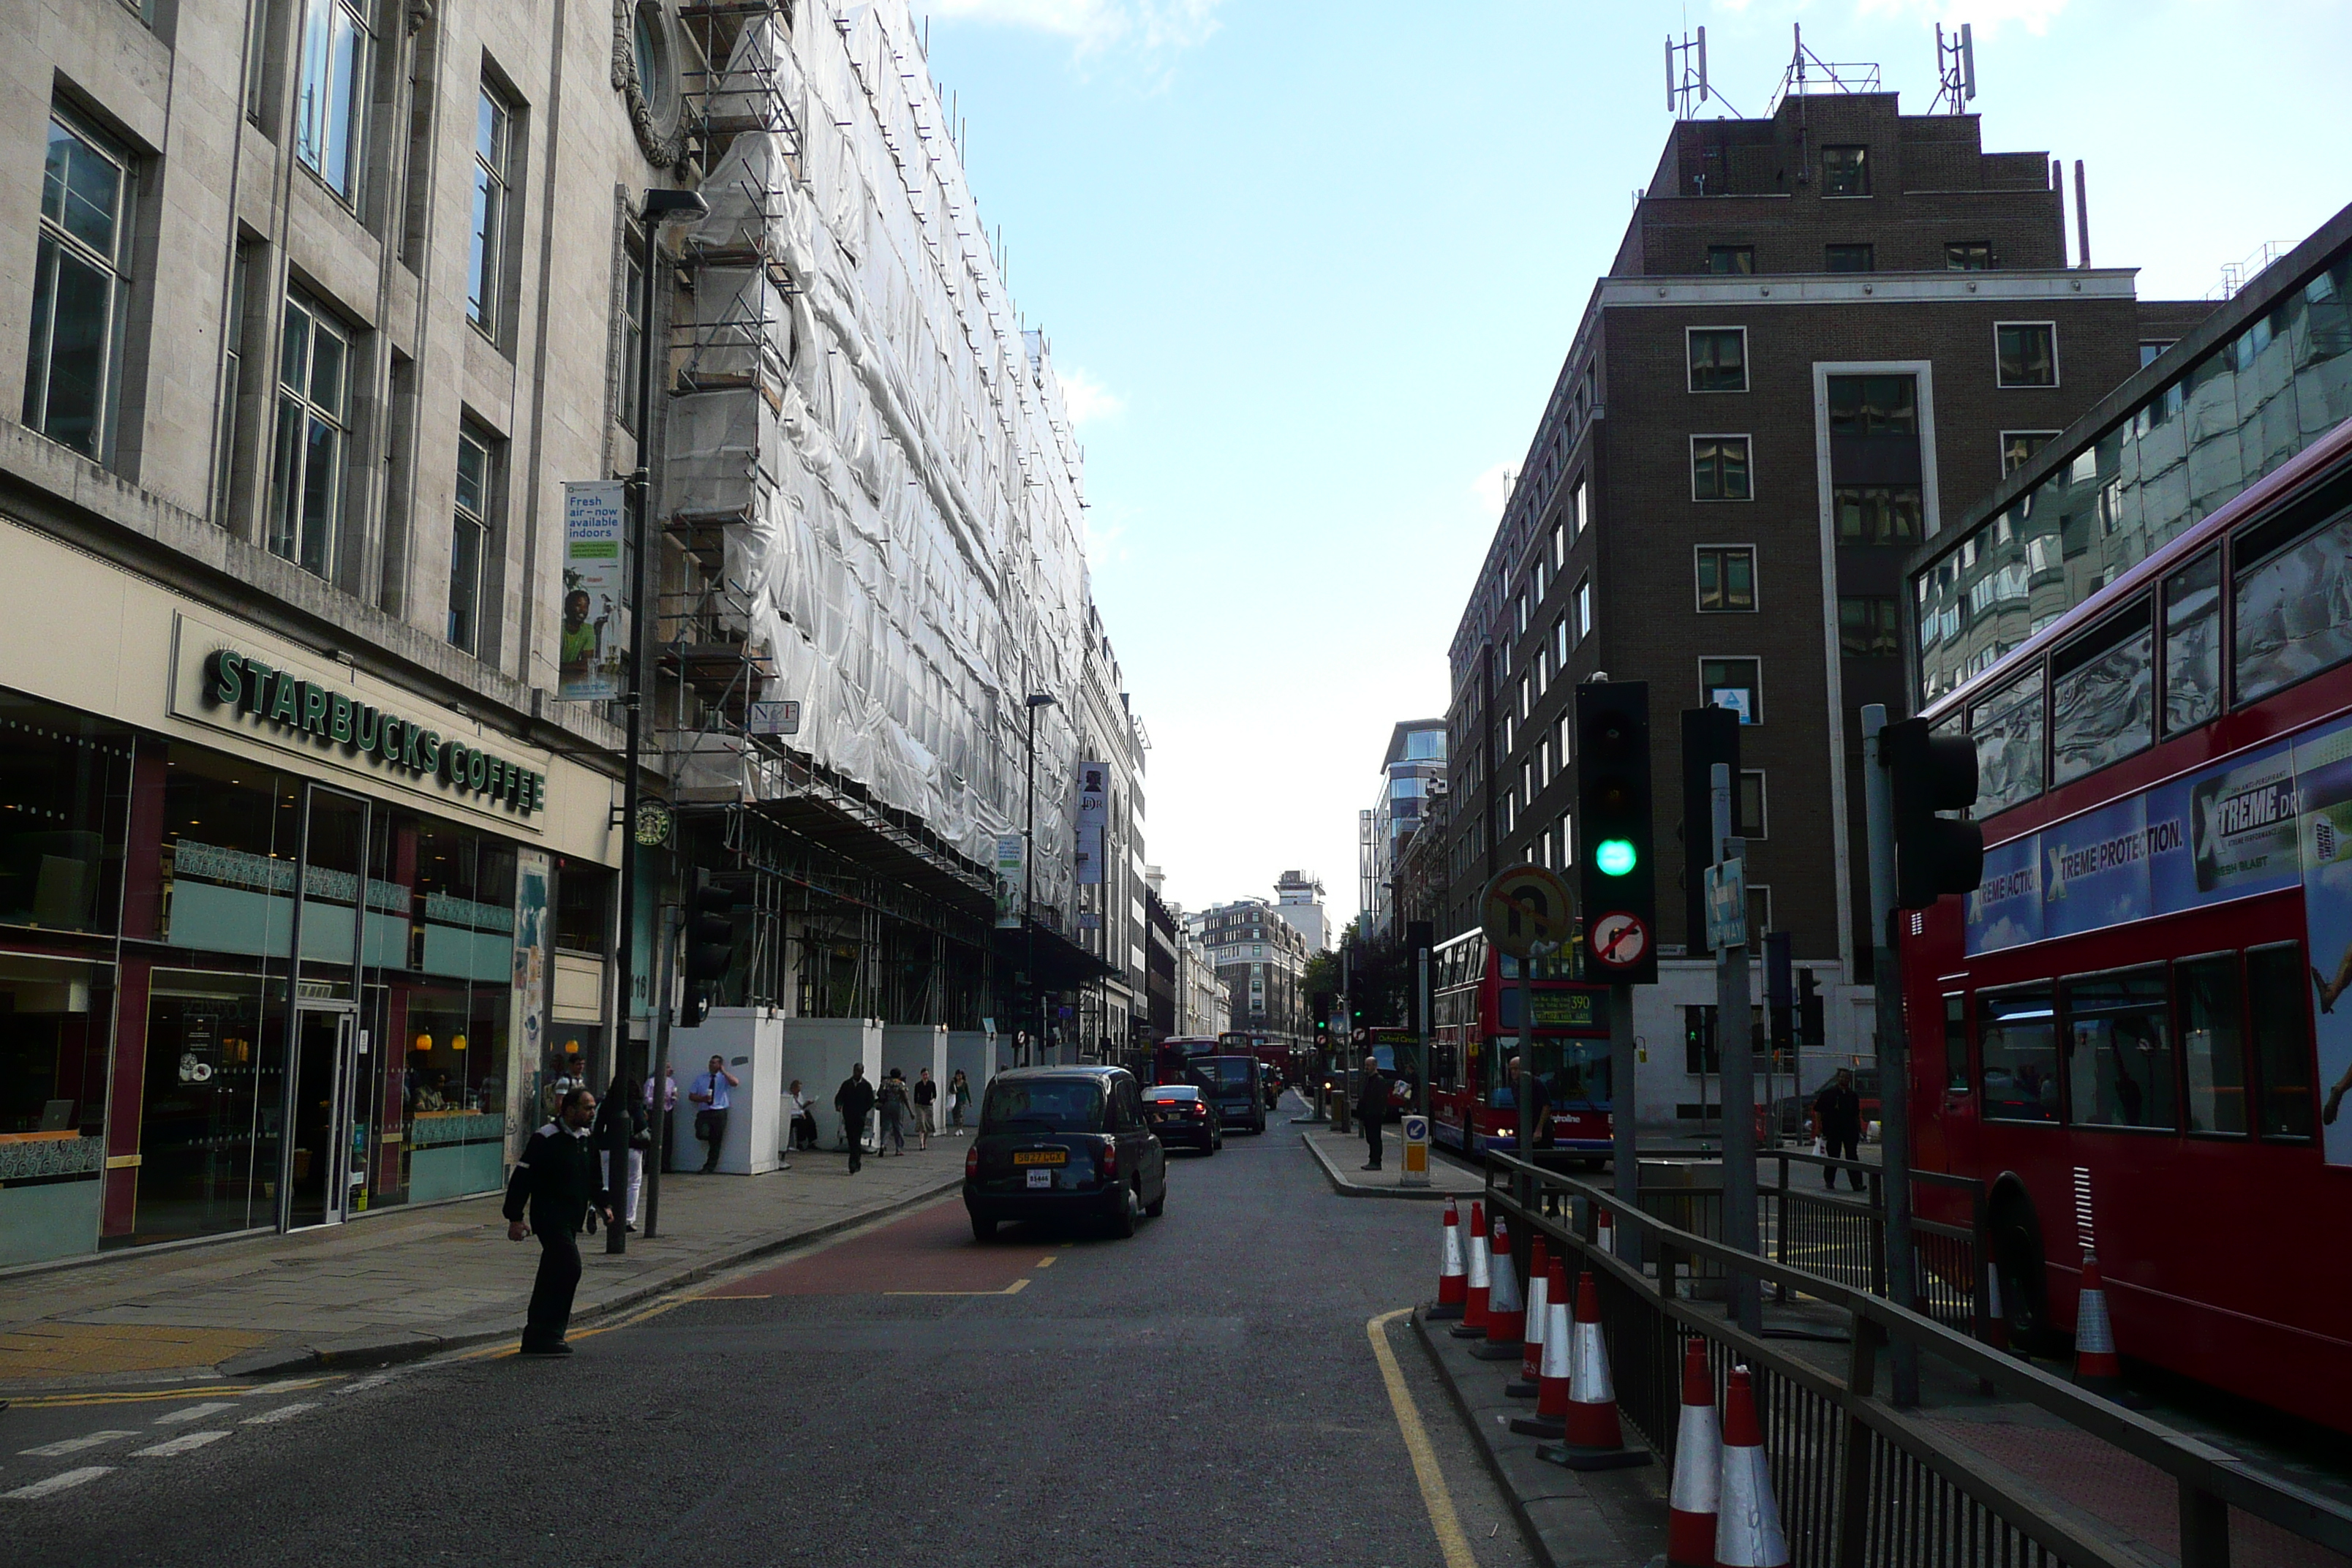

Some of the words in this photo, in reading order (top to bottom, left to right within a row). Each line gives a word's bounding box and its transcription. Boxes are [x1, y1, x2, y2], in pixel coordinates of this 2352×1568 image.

[570, 496, 602, 506] Fresh
[570, 507, 585, 516] air
[595, 508, 618, 516] now
[569, 516, 618, 527] available
[569, 528, 612, 538] indoors
[218, 649, 441, 774] STARBUCKS
[449, 739, 546, 812] COFFEE
[2316, 823, 2325, 860] GUARD
[2323, 825, 2332, 858] RIGHT
[2047, 844, 2097, 902] XTREME
[2100, 820, 2183, 870] PROTECTION.
[1571, 995, 1591, 1010] 390
